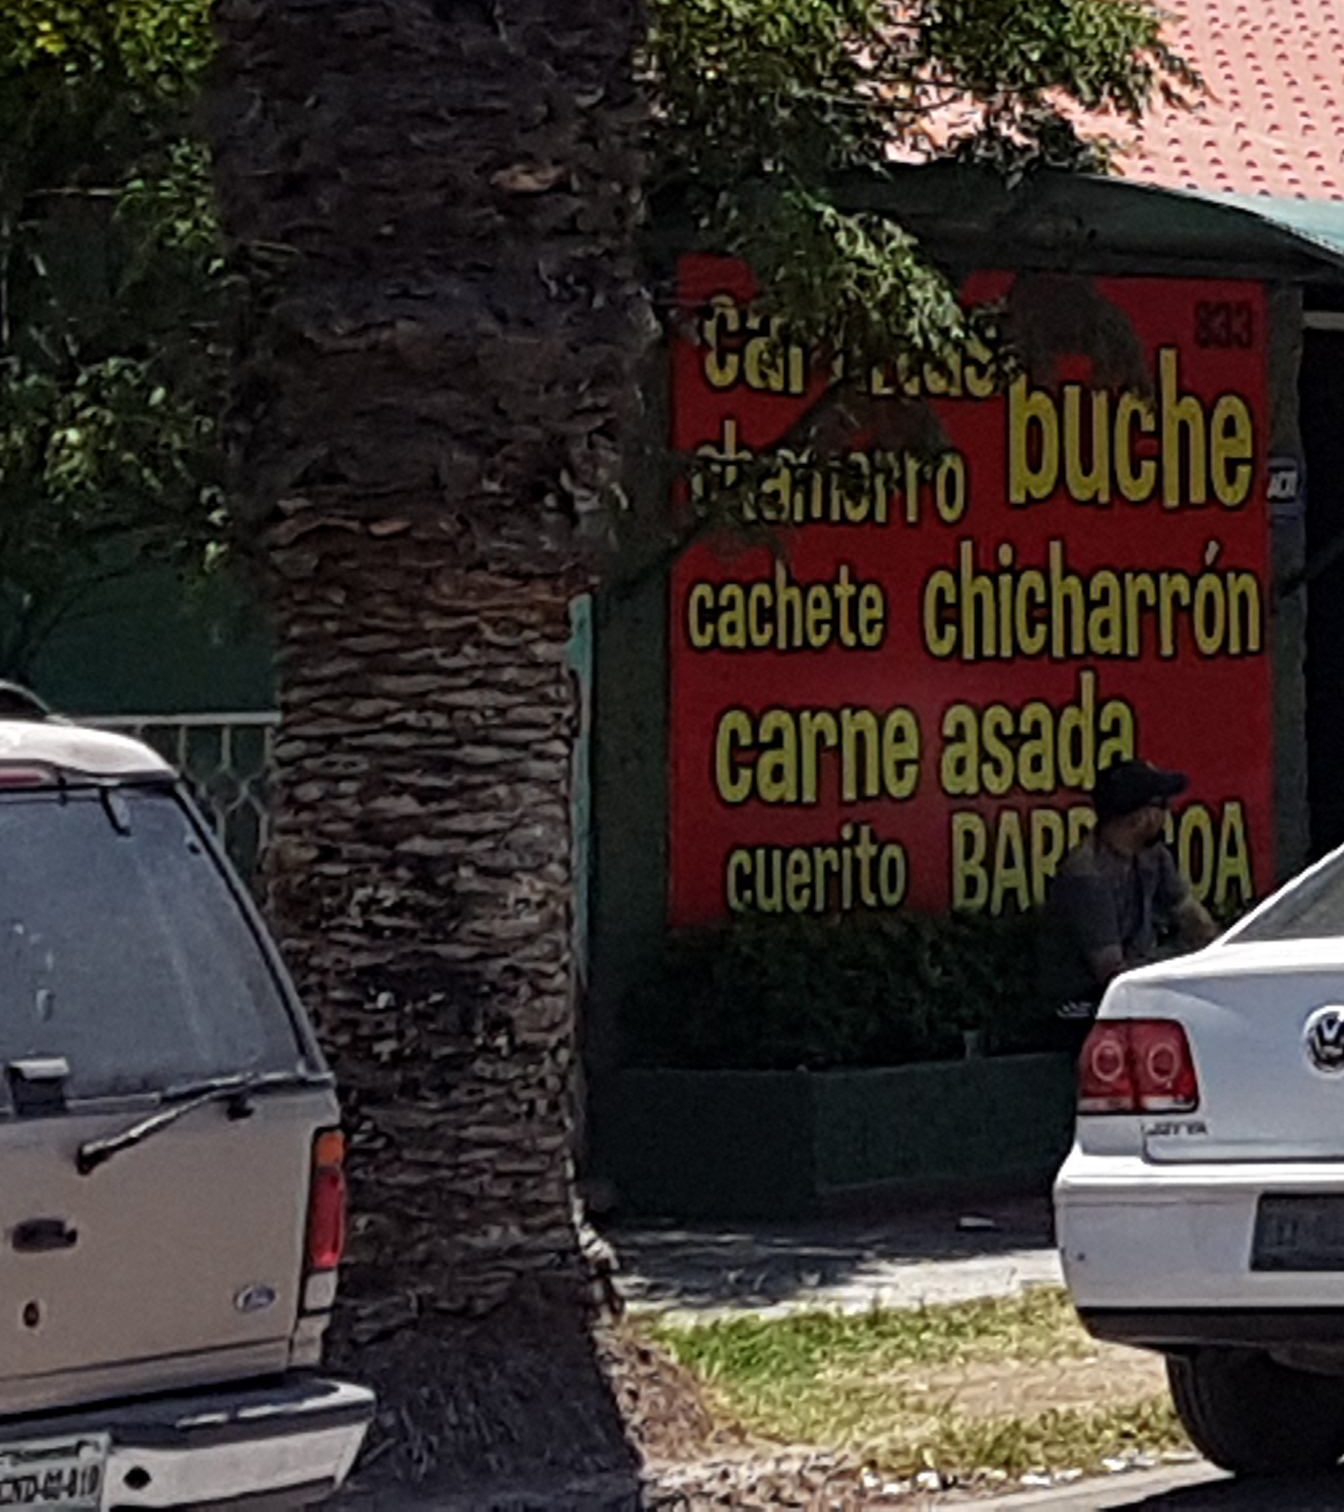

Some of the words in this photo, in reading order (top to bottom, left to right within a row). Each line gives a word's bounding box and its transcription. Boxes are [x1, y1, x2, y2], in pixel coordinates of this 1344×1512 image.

[1008, 348, 1254, 508] buche
[688, 560, 885, 650] cachete
[923, 540, 1261, 660] chicharrón
[715, 706, 920, 805] carne
[941, 670, 1135, 796] asada
[727, 825, 906, 912] cuerito
